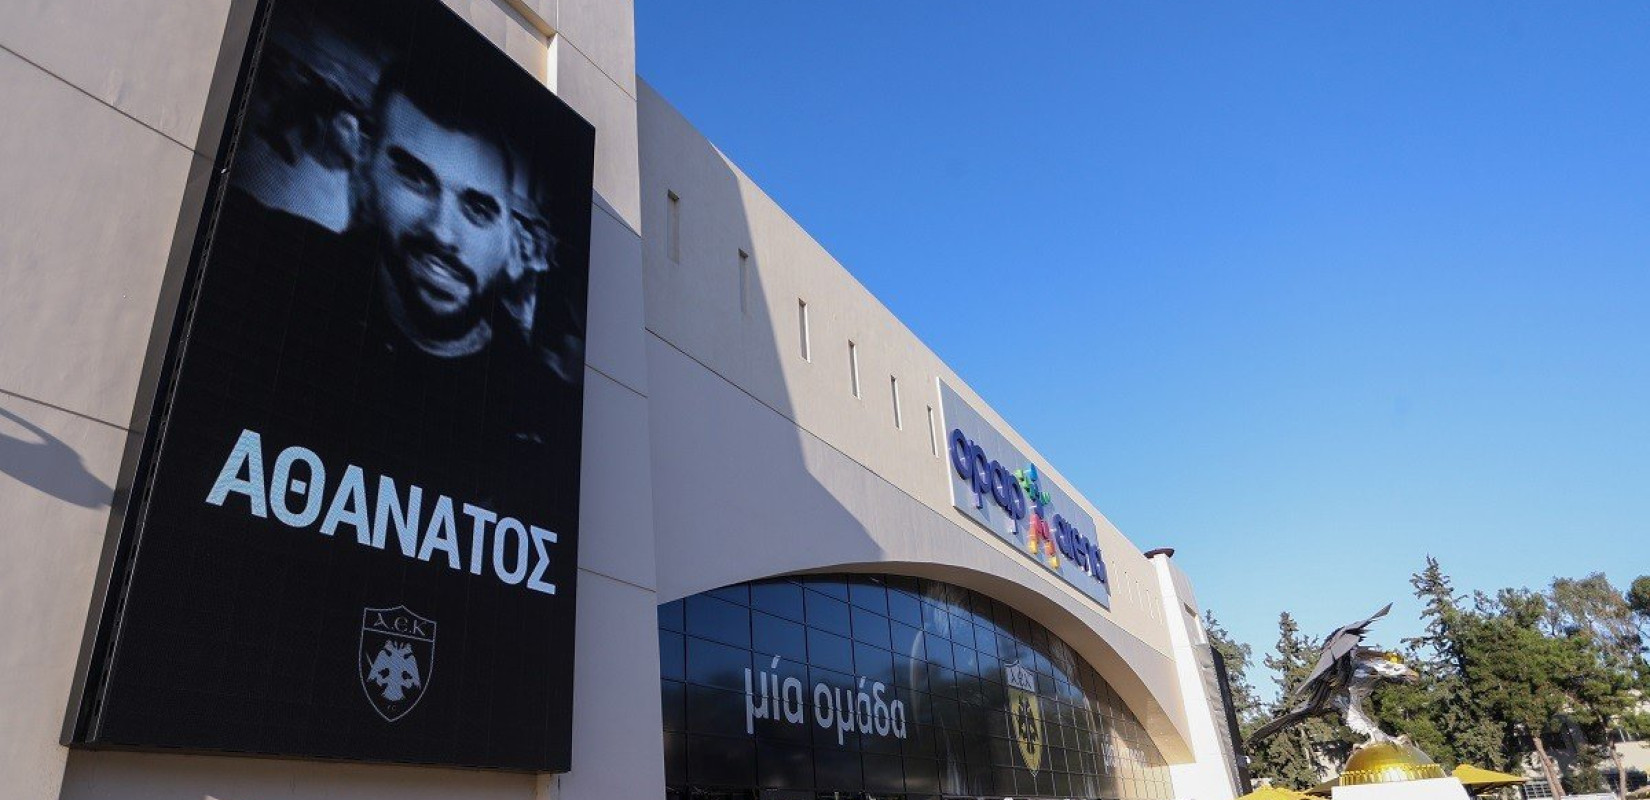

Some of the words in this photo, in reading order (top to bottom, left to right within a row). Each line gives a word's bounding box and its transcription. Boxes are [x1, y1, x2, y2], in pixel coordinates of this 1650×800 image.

[205, 428, 558, 595] ΑΘΑΝΑΤΟΣ
[951, 428, 1025, 534] opap
[744, 655, 804, 735] μία
[813, 675, 907, 745] ομάδα
